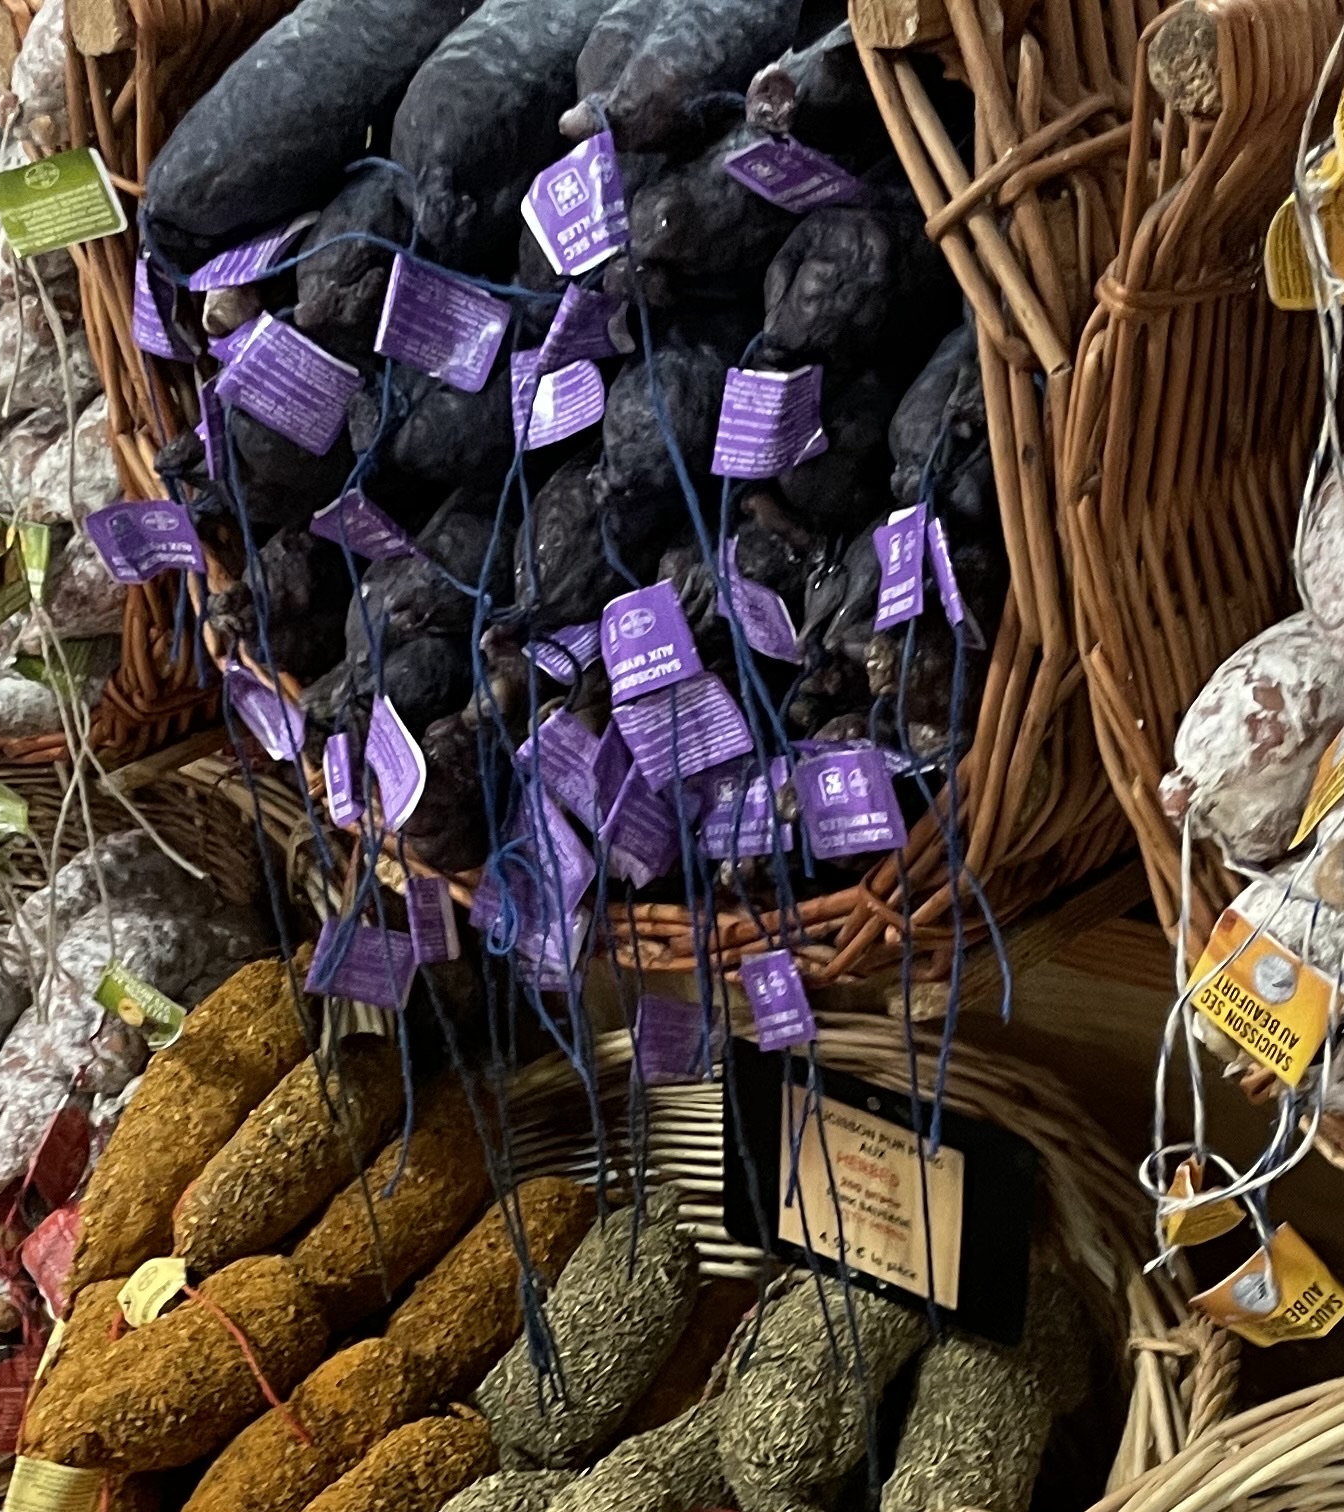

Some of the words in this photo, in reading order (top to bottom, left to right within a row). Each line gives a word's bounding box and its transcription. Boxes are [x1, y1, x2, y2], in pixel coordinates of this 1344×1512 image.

[647, 643, 674, 663] AUX
[1199, 988, 1227, 1017] SEC
[1212, 973, 1282, 1036] BEAUFORT
[1223, 1008, 1294, 1072] SAUCISSON
[1277, 1026, 1302, 1050] AU
[1302, 1281, 1324, 1305] AU
